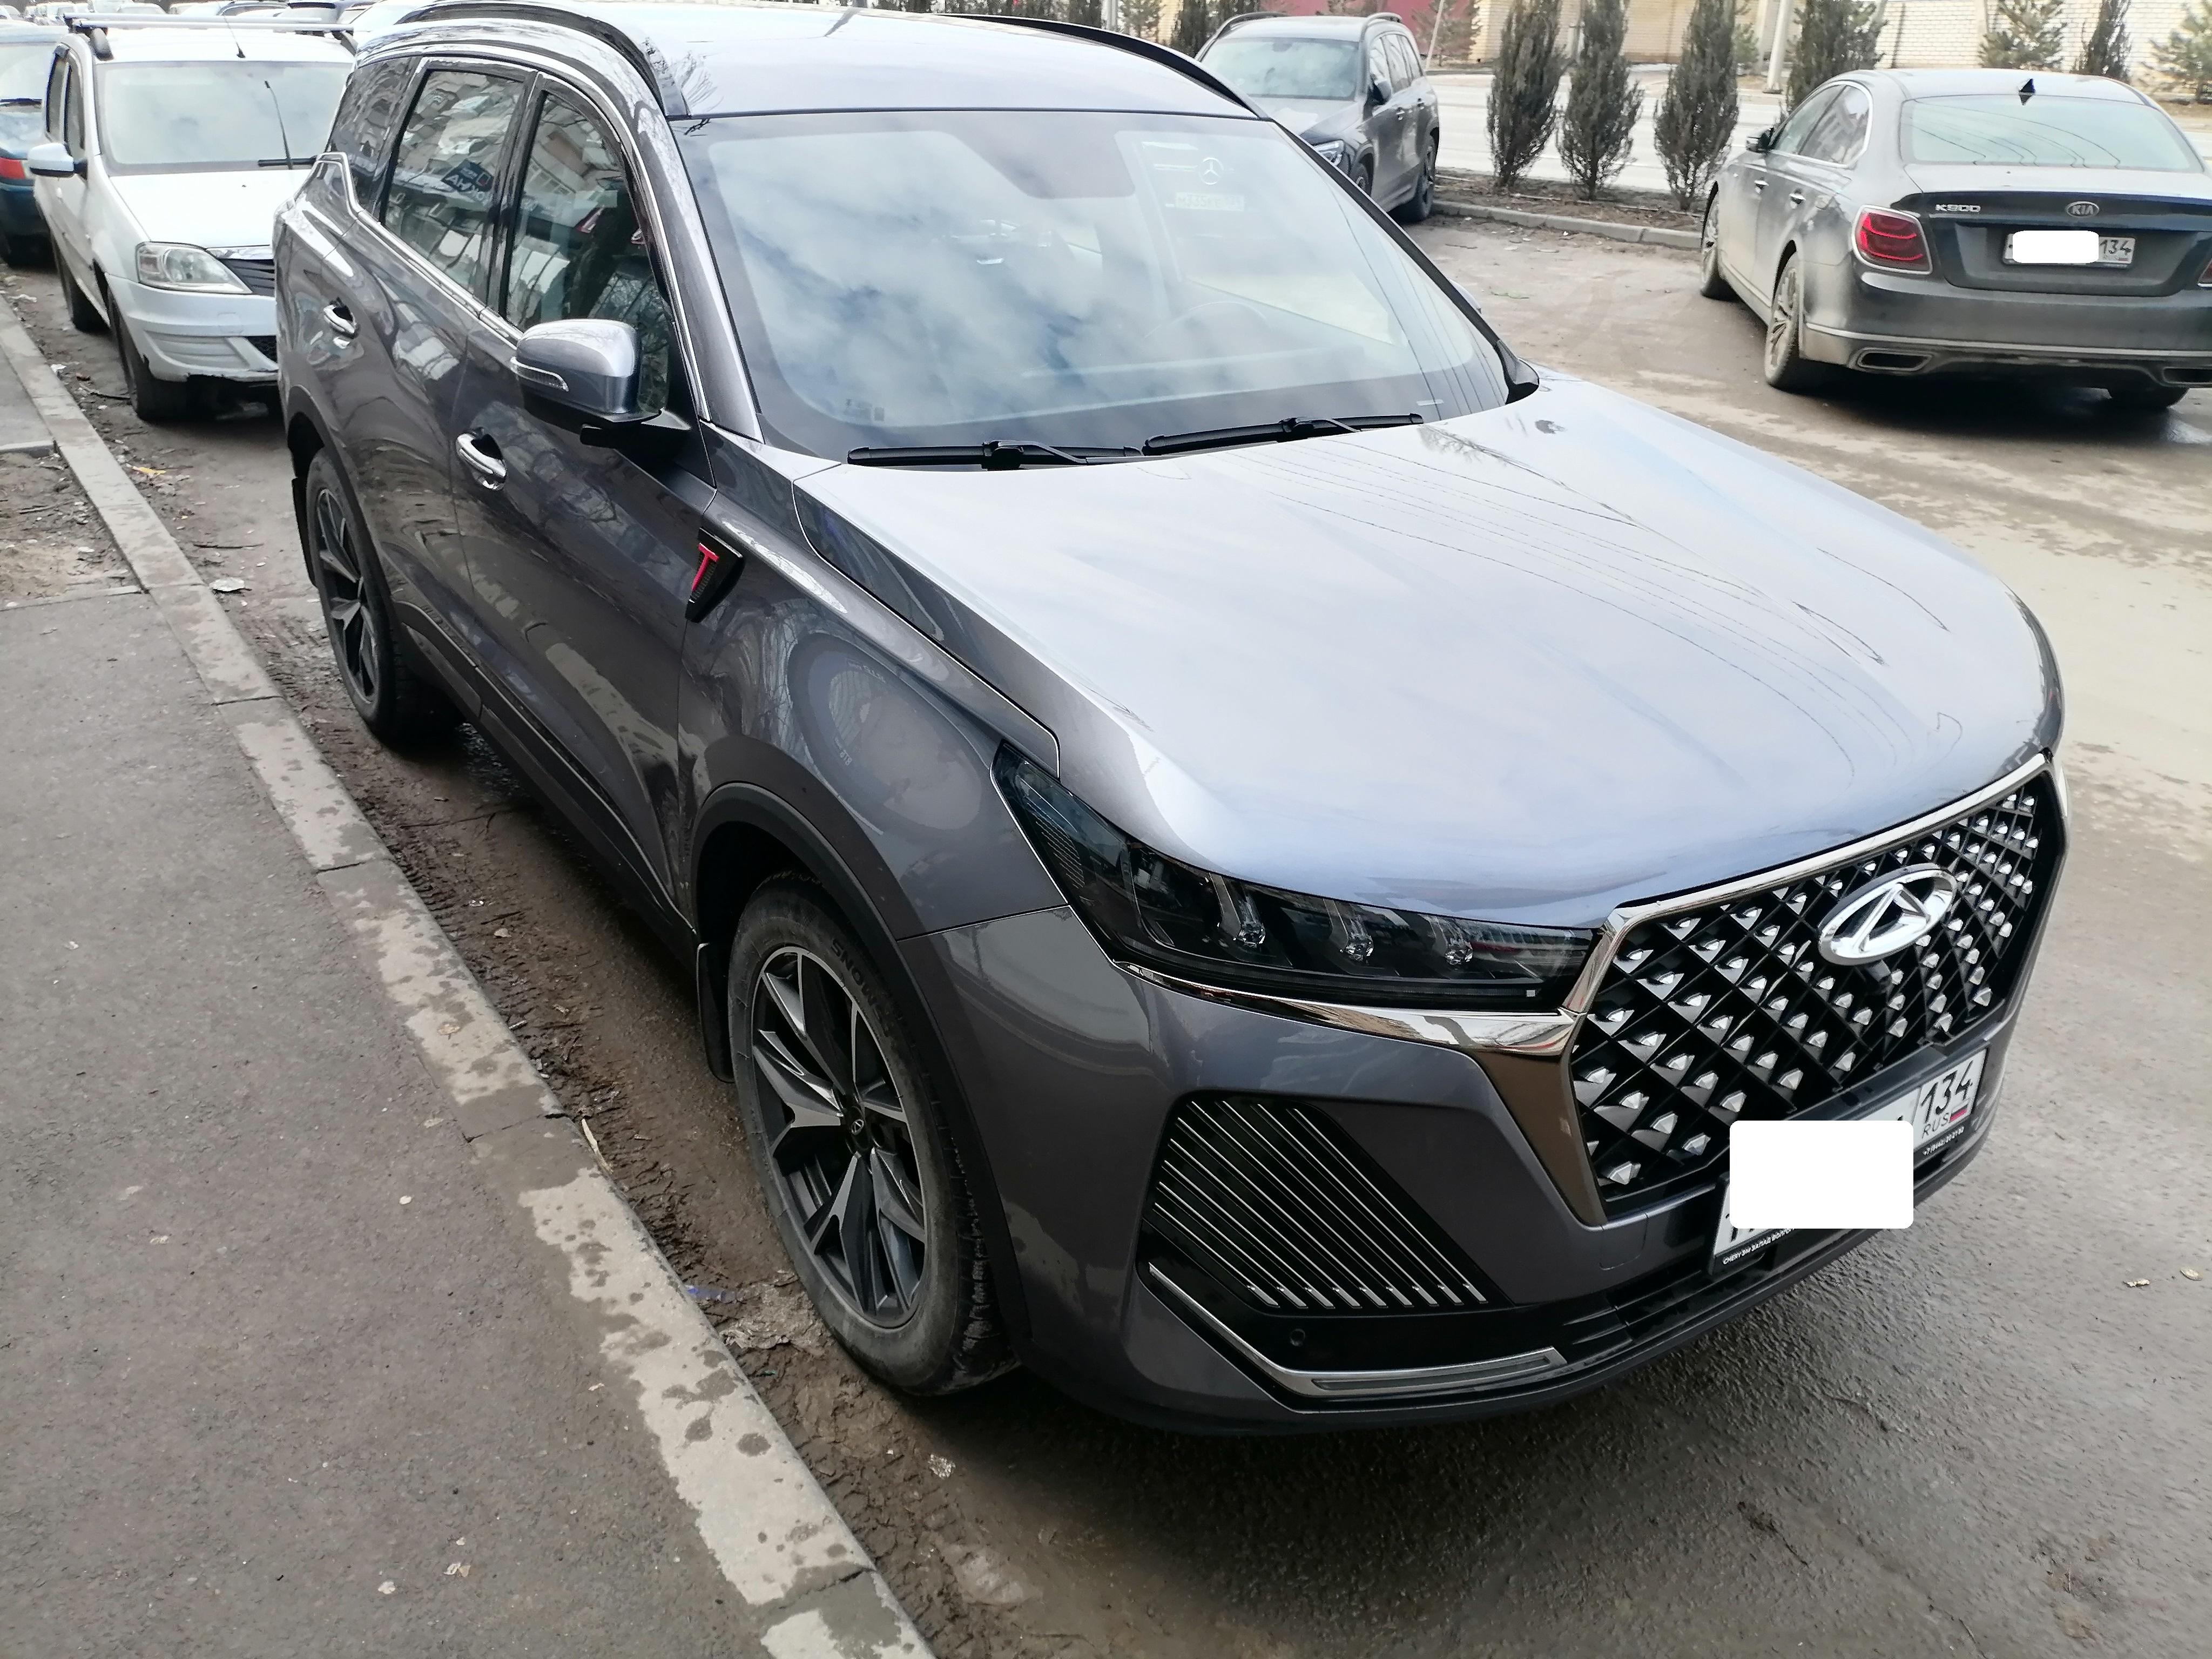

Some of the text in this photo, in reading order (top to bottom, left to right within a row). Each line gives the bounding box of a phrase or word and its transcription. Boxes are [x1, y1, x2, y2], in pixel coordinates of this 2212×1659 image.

[2072, 204, 2094, 215] KIA
[2100, 239, 2132, 255] 134
[1920, 1060, 1973, 1123] 134
[1922, 1112, 1949, 1139] RUS
